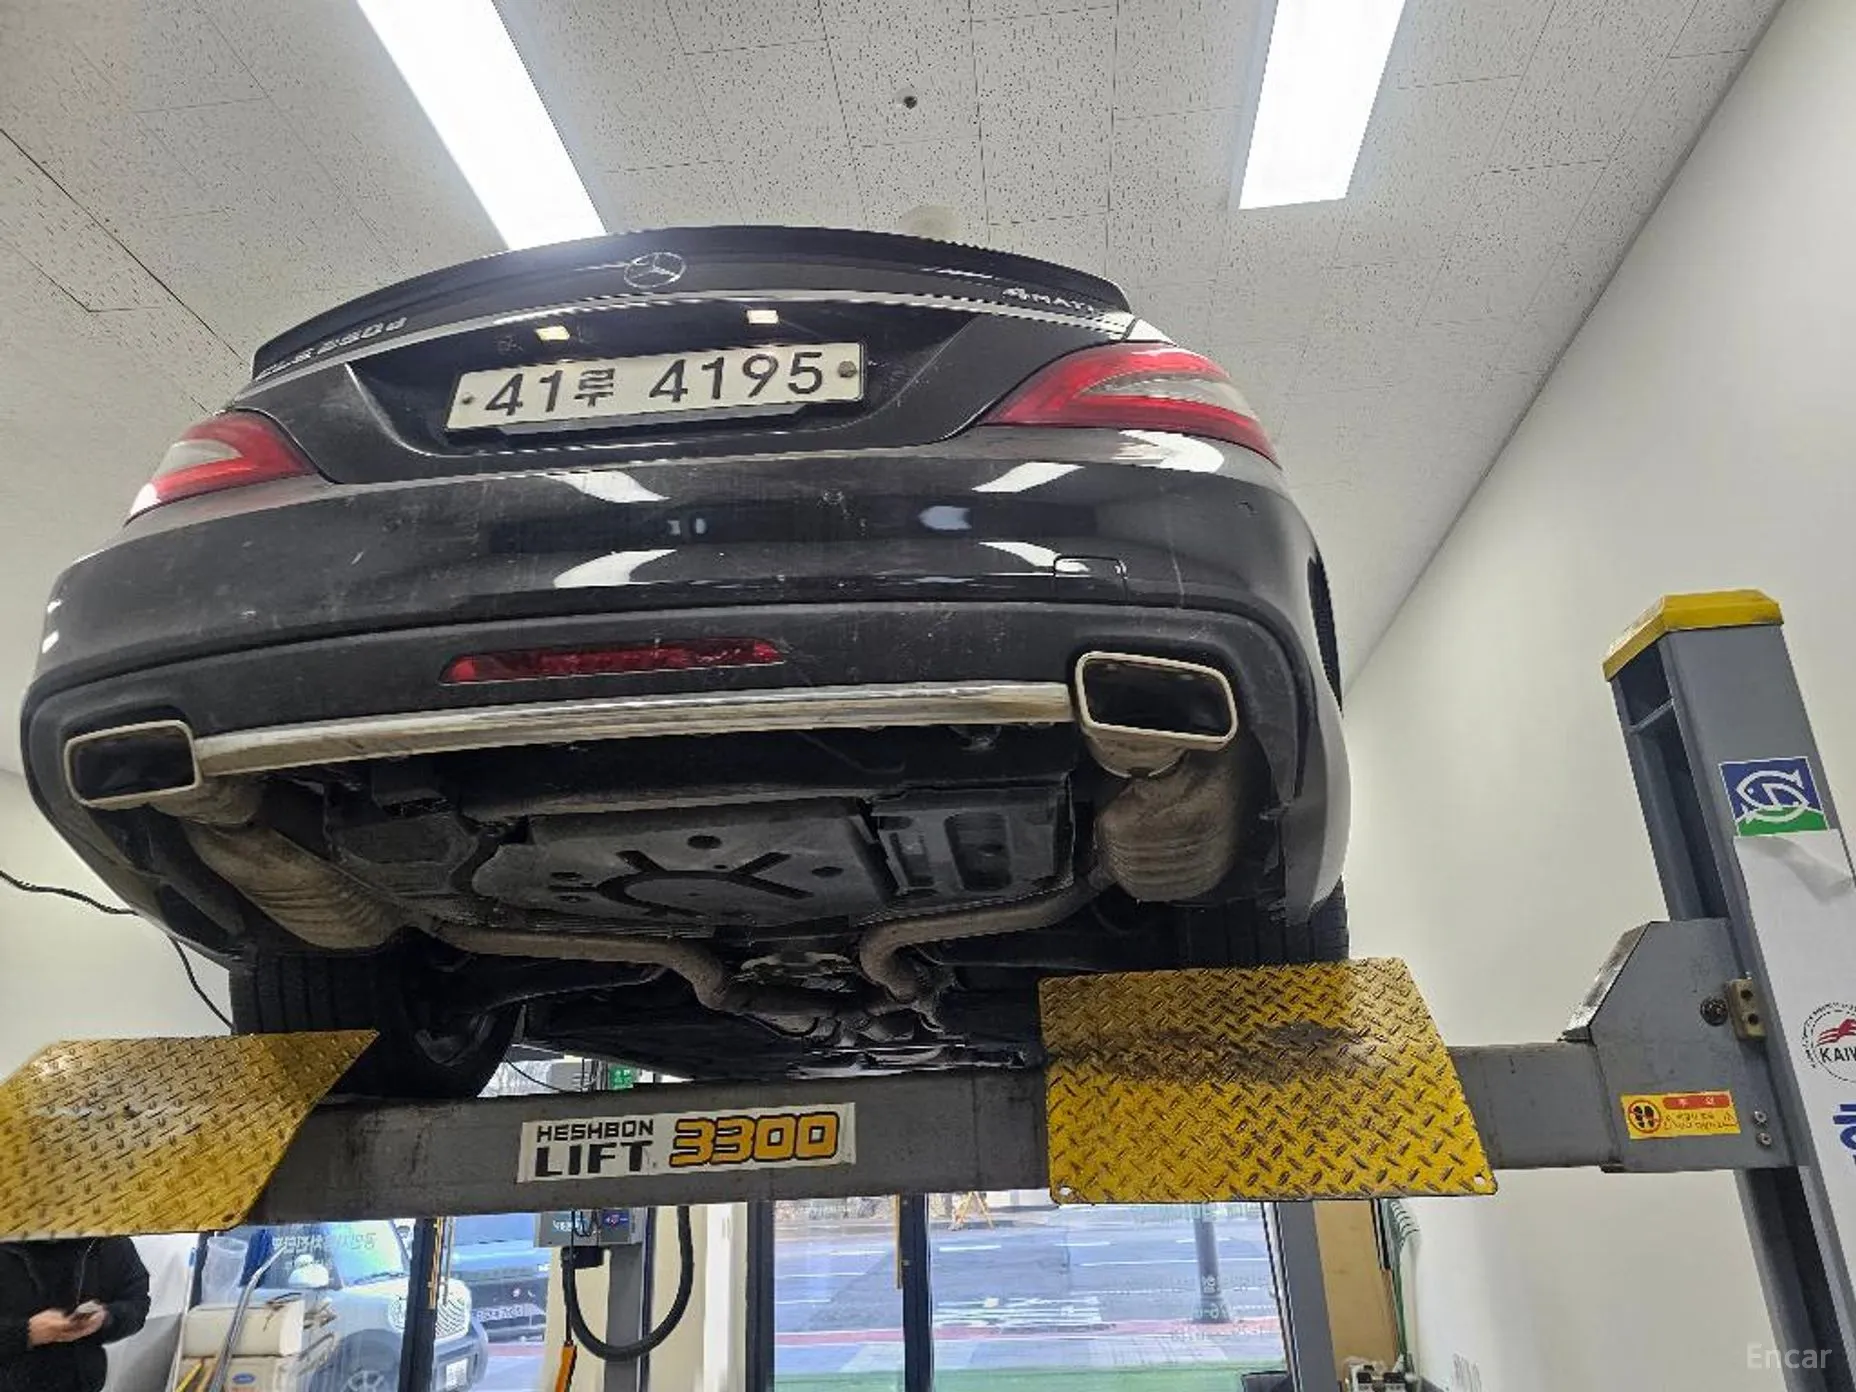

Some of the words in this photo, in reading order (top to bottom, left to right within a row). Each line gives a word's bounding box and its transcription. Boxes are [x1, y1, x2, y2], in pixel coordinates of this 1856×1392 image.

[484, 368, 616, 417] 41루
[649, 352, 823, 403] 4195
[535, 1140, 653, 1178] LIFT
[669, 1111, 839, 1168] 3300
[536, 1119, 654, 1143] HESHBON
